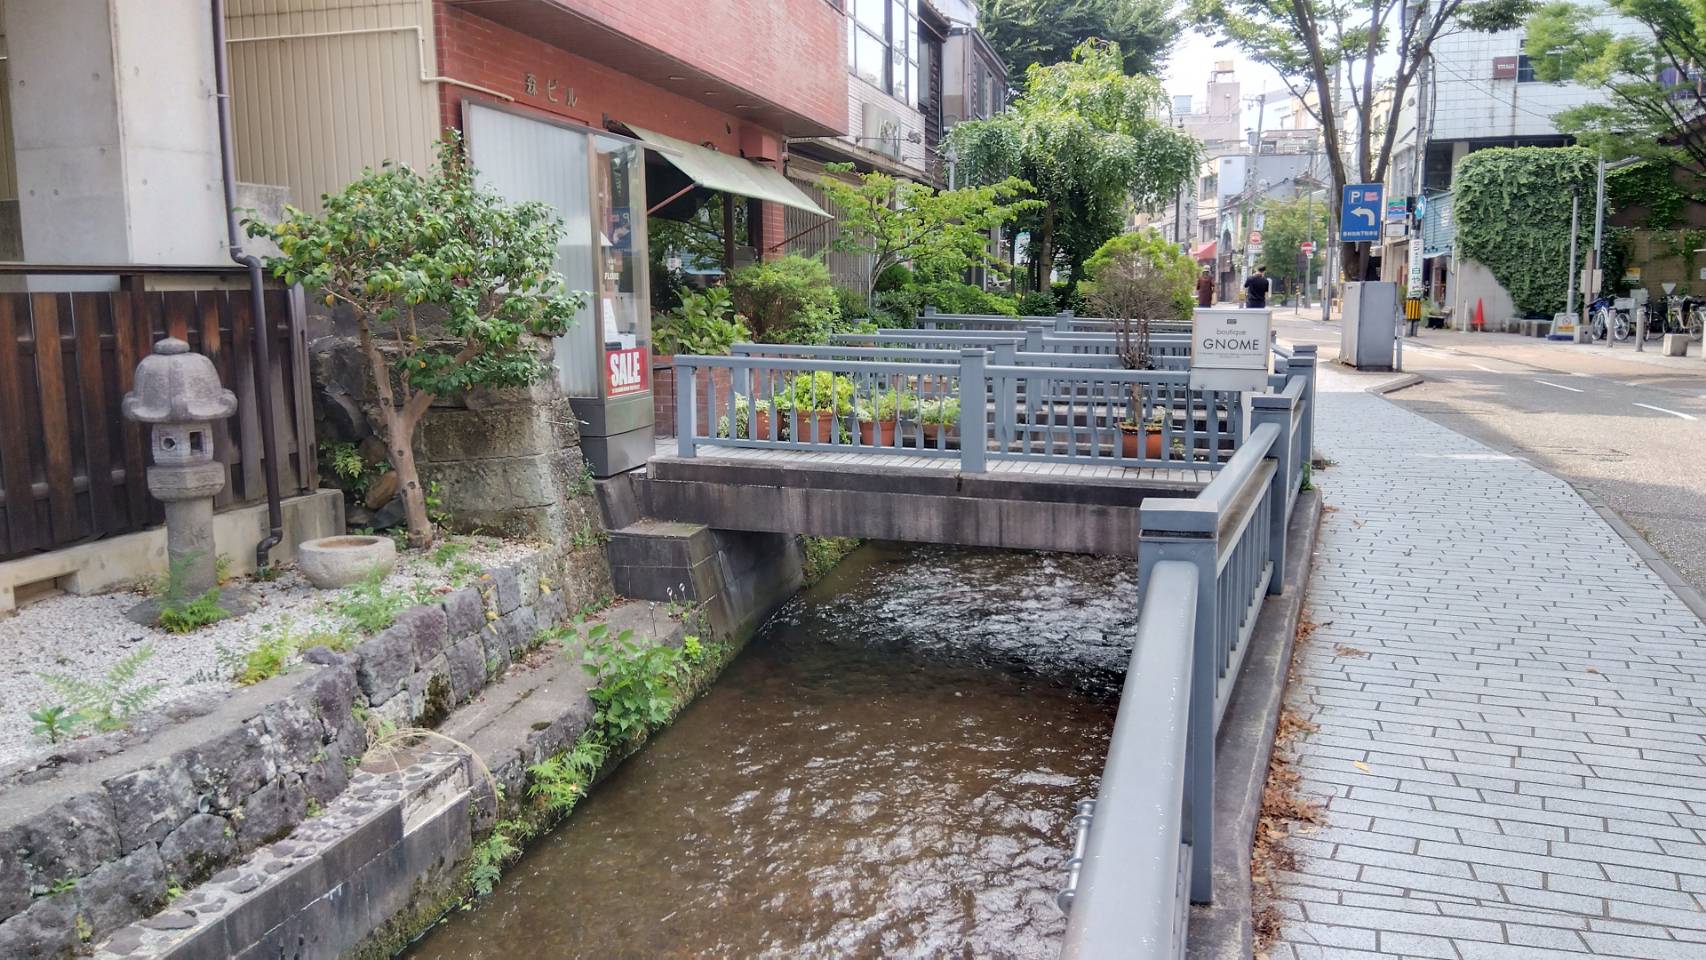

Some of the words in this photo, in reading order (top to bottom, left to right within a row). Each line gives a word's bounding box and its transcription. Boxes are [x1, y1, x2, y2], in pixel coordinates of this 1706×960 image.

[1351, 191, 1361, 203] P
[1216, 328, 1247, 337] boutique
[1203, 338, 1260, 350] GNOME
[610, 351, 641, 387] SALE
